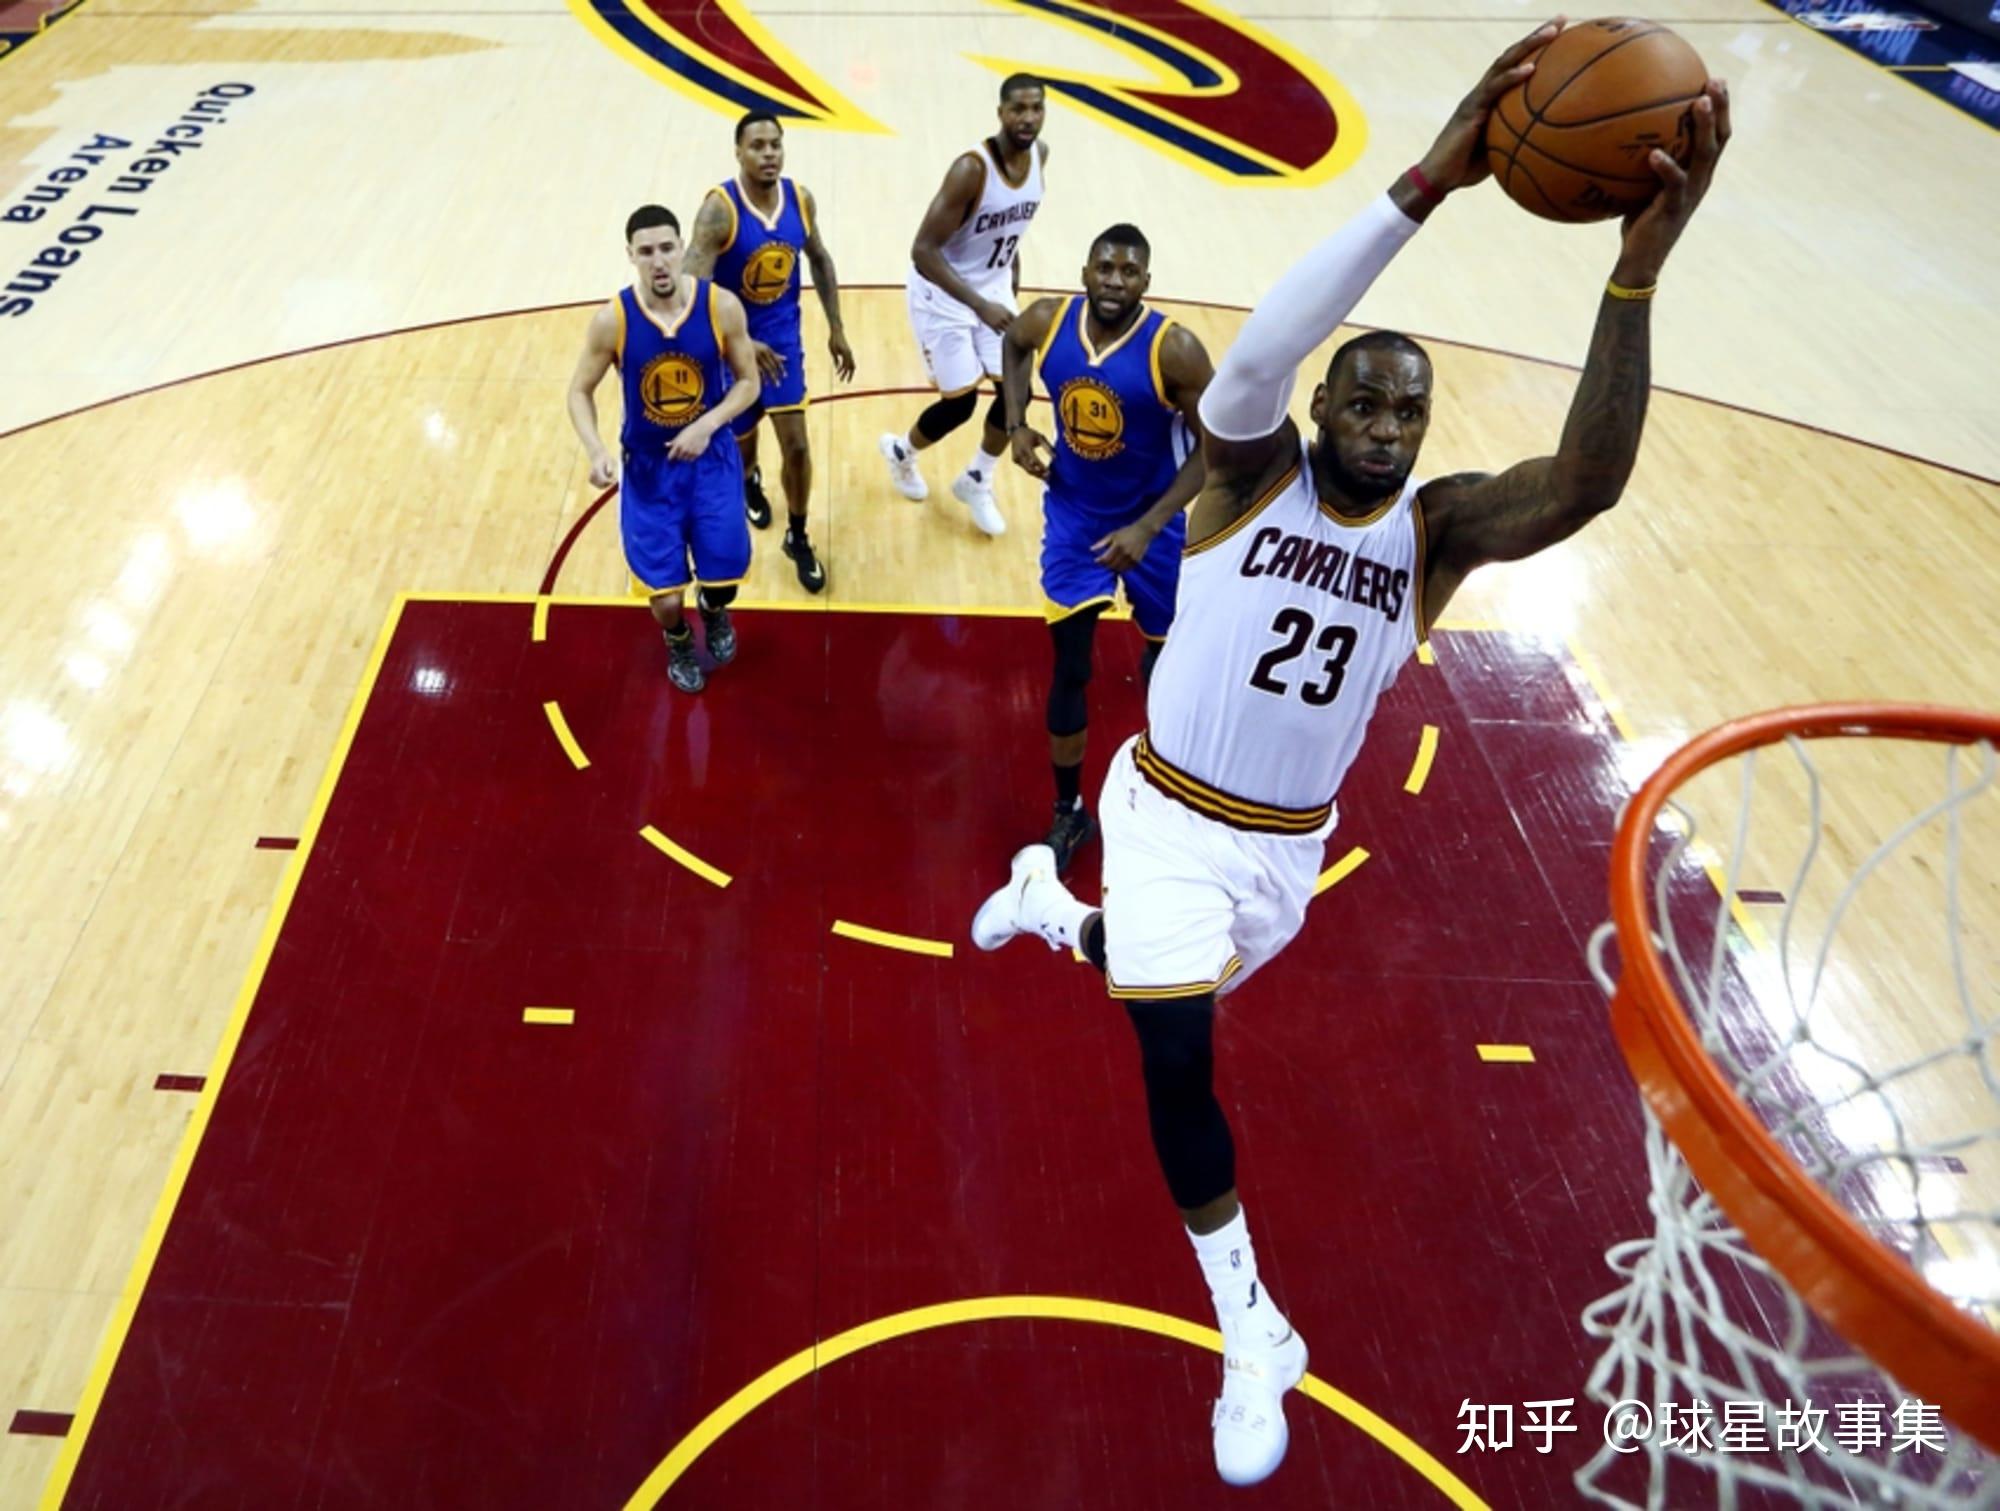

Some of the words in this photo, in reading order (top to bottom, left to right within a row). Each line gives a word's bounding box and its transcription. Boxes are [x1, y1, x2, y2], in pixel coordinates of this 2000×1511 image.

[0, 133, 133, 224] Arena
[108, 82, 256, 193] Quicken
[0, 204, 140, 318] Loans
[974, 201, 1042, 234] CAVALIER
[986, 233, 1020, 270] 13
[675, 368, 689, 385] 11
[1089, 400, 1108, 420] 31
[1240, 526, 1410, 623] CAVALIERS
[1248, 605, 1359, 707] 23
